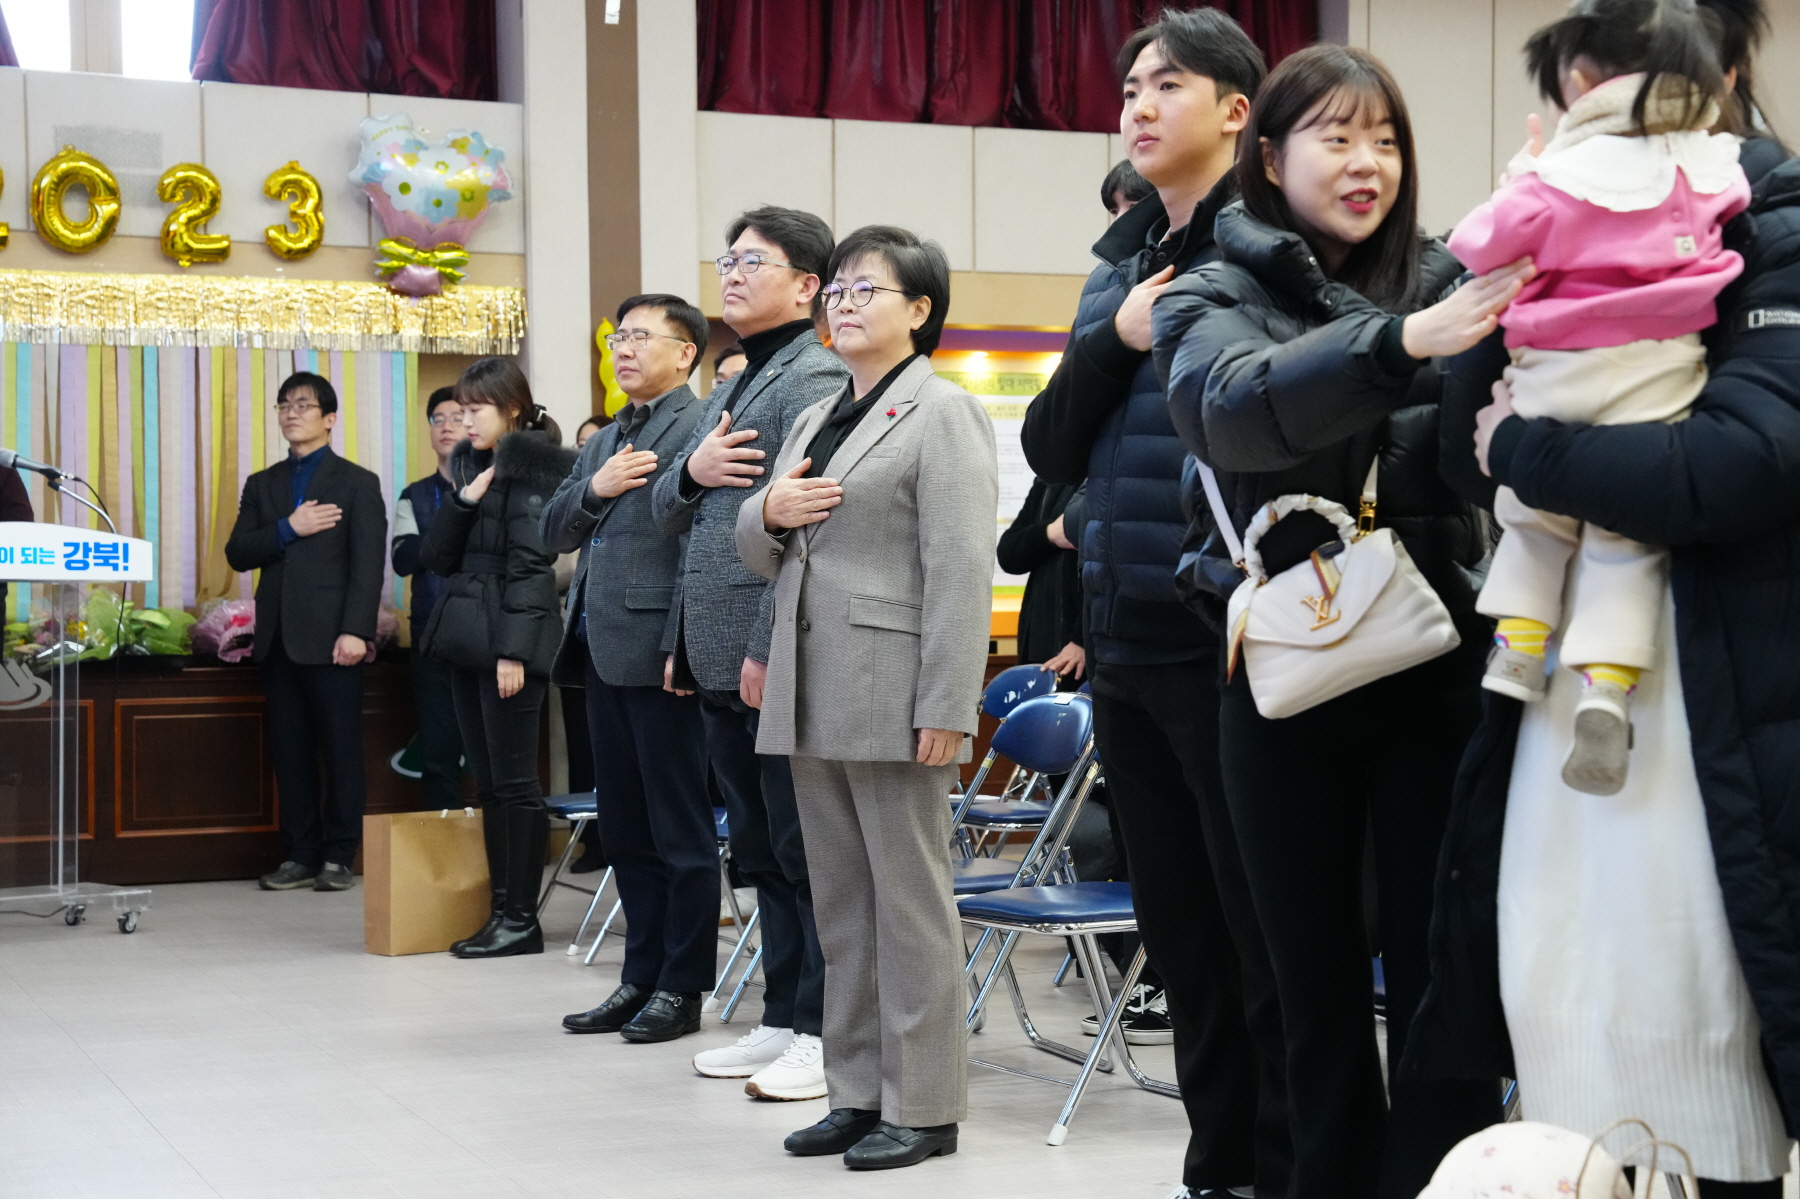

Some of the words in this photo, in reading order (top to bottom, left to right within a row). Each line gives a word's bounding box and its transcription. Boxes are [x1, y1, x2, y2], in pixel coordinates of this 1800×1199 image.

[0, 145, 324, 265] 023
[21, 547, 55, 565] 되는
[63, 542, 129, 571] 강북!
